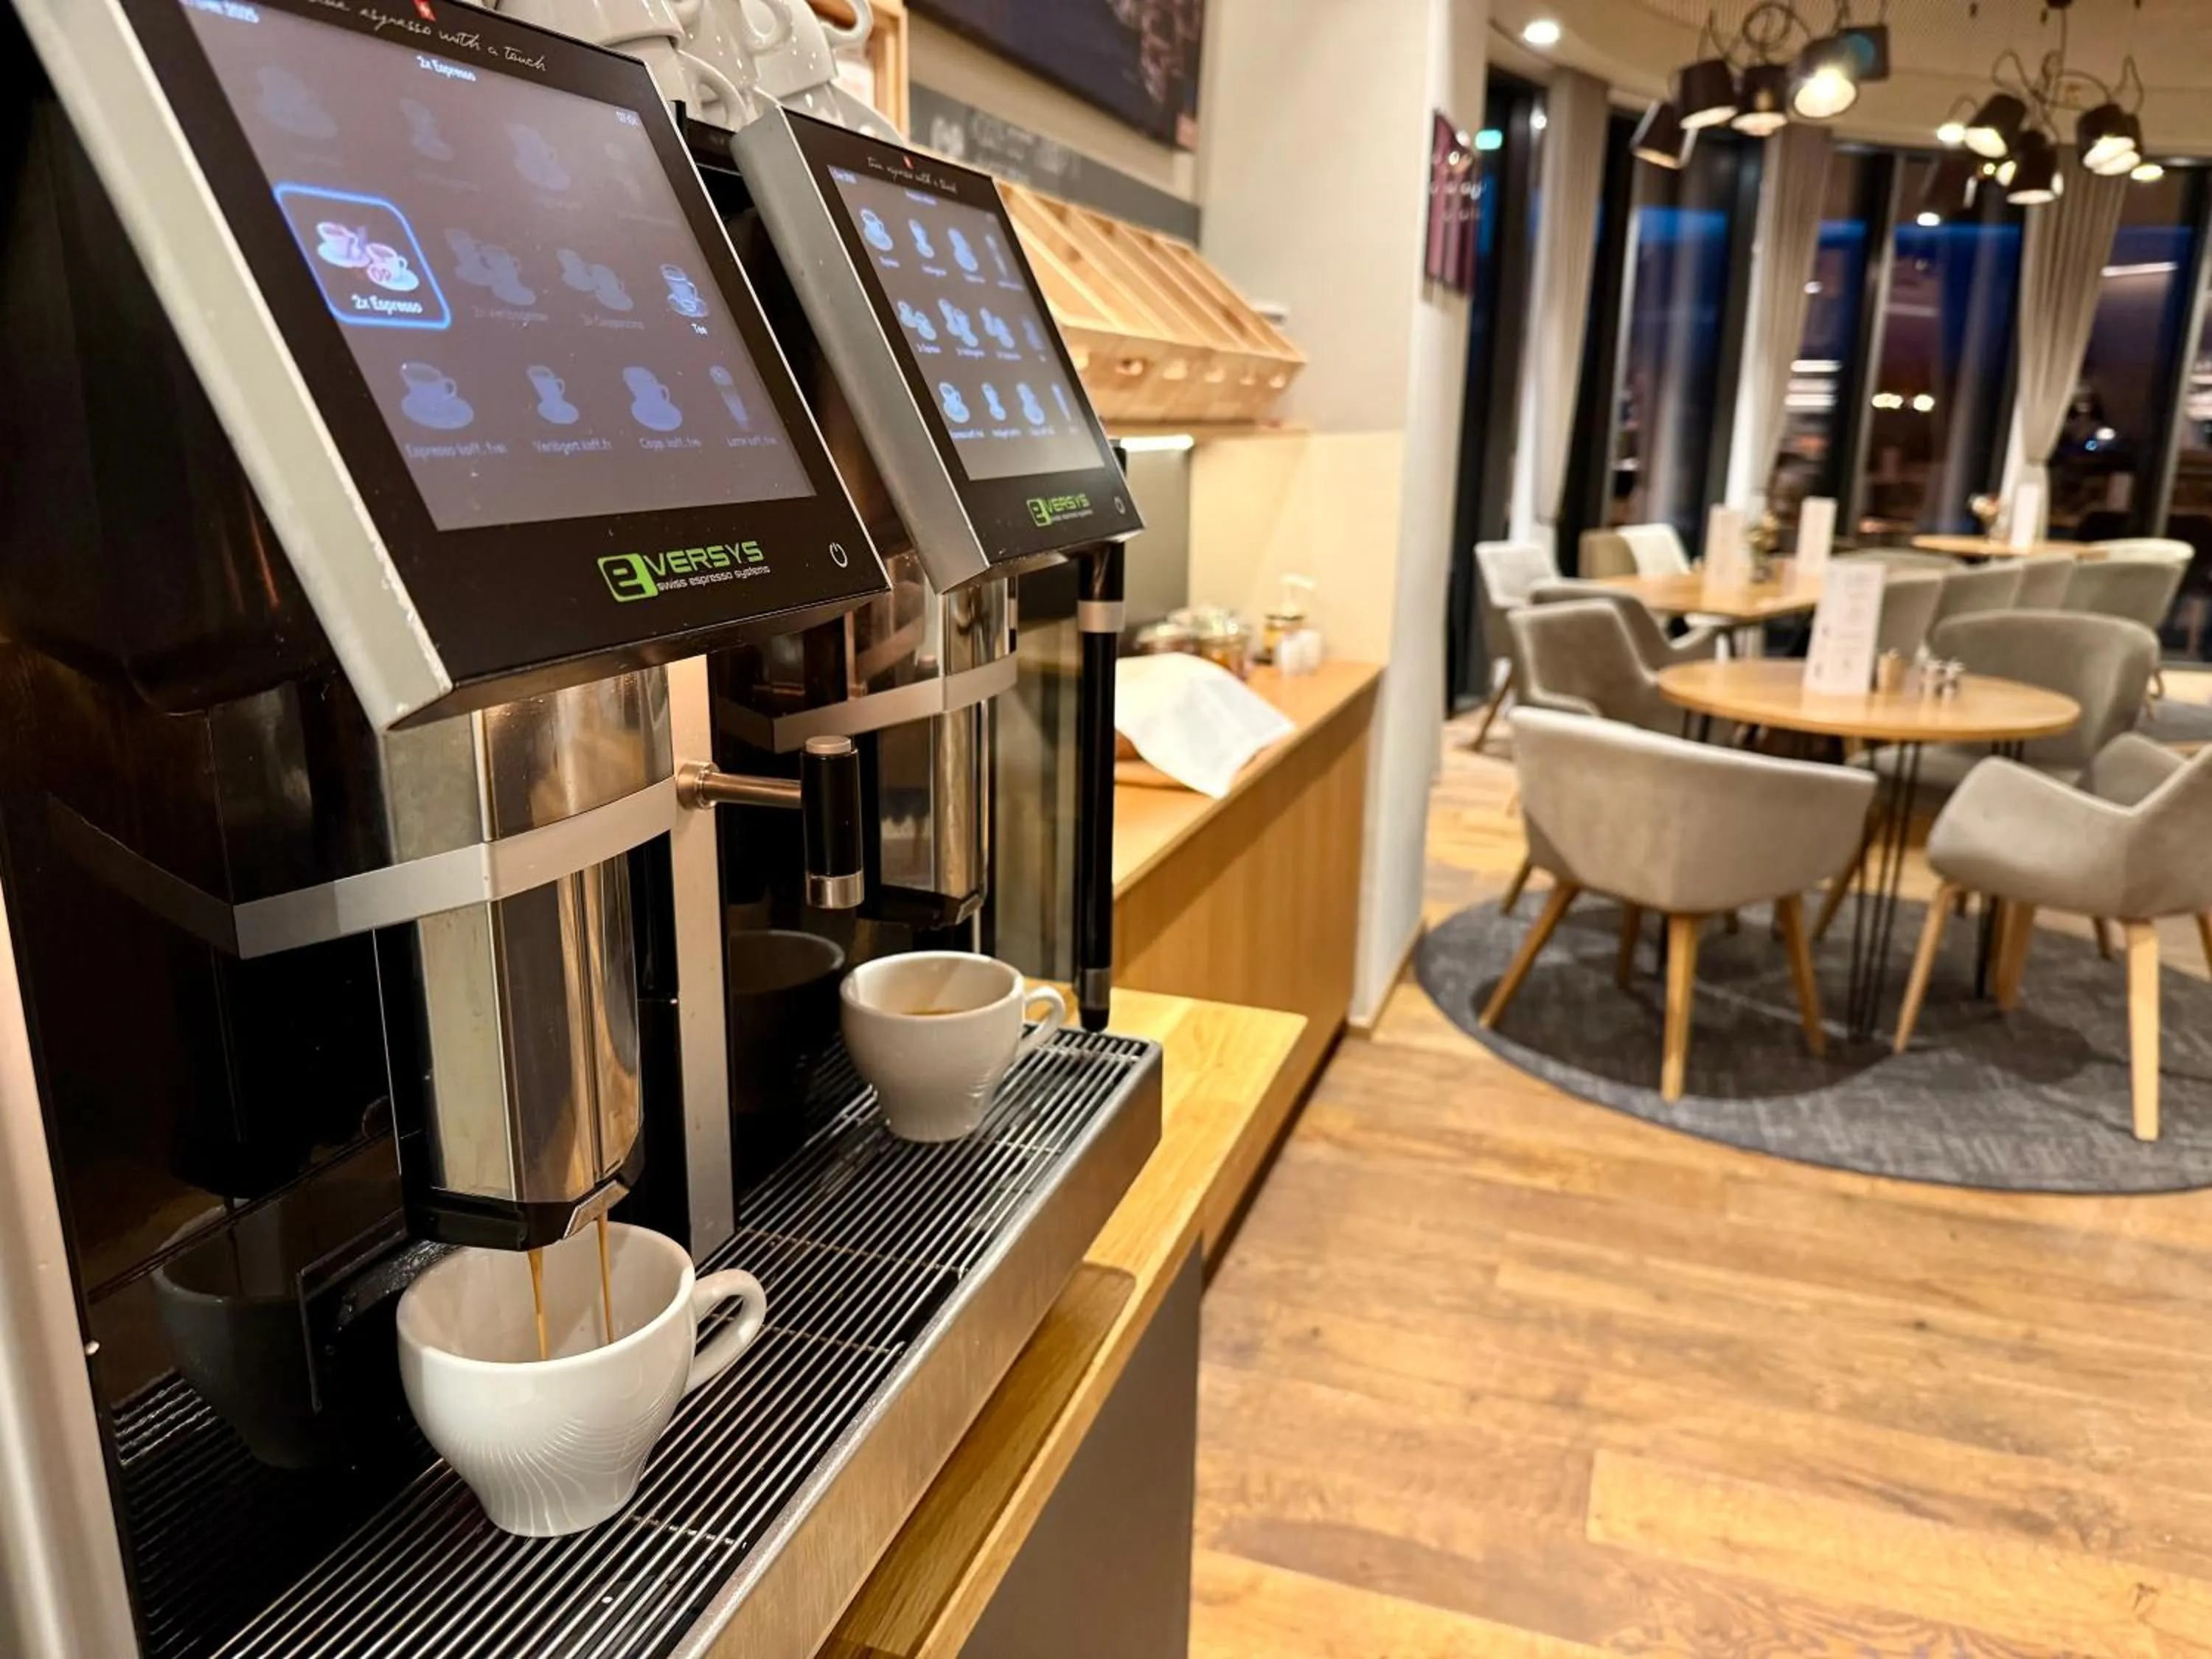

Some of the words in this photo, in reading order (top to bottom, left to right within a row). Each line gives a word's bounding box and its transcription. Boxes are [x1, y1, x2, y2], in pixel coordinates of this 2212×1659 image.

[439, 30, 481, 51] with
[487, 46, 498, 56] a
[351, 293, 370, 310] 2x
[369, 295, 422, 316] Espresso
[656, 578, 688, 592] swiss
[689, 572, 734, 589] espresso
[734, 565, 771, 580] systems
